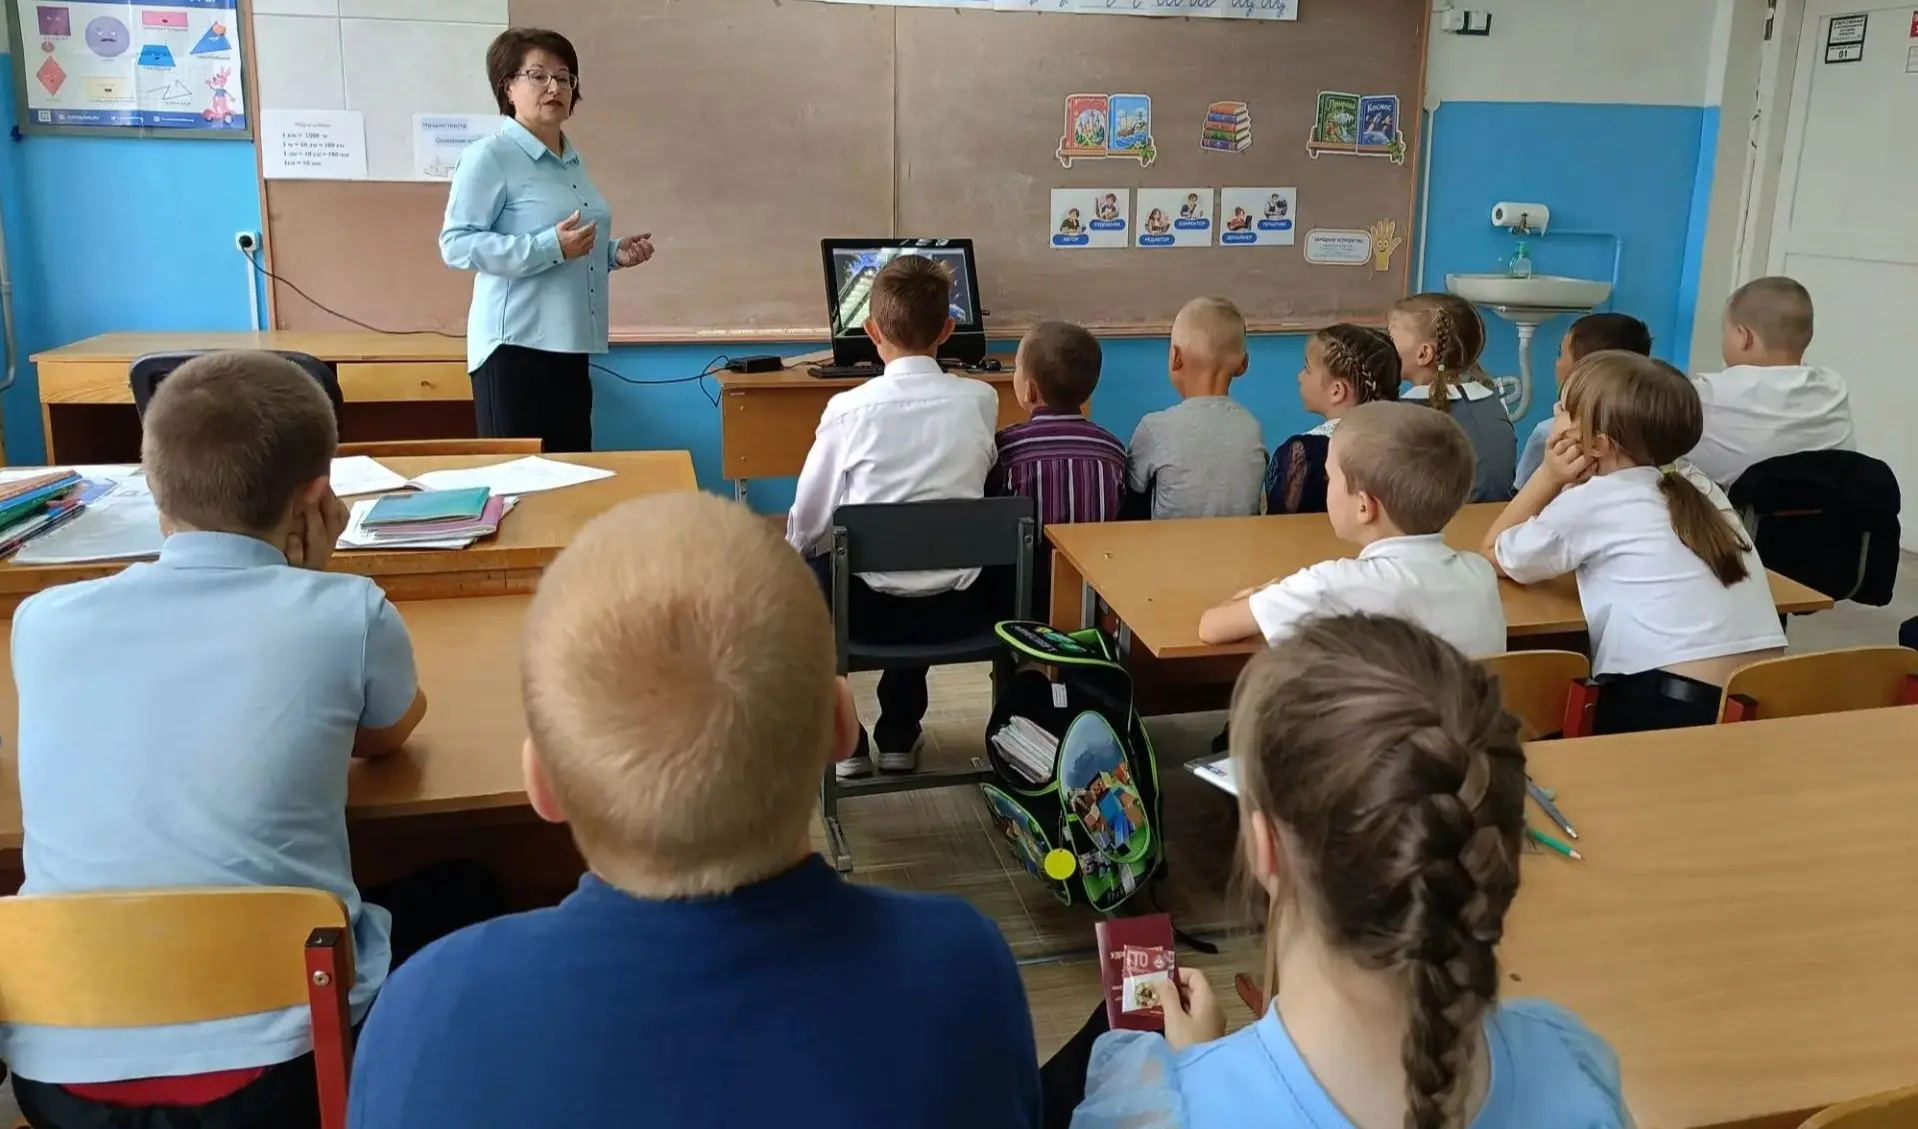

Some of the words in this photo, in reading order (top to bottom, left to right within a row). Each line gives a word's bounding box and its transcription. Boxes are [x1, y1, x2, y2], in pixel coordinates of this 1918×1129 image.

[1838, 50, 1848, 58] 01
[1367, 102, 1392, 113] Космос
[1144, 236, 1170, 244] РЕДАКТОР
